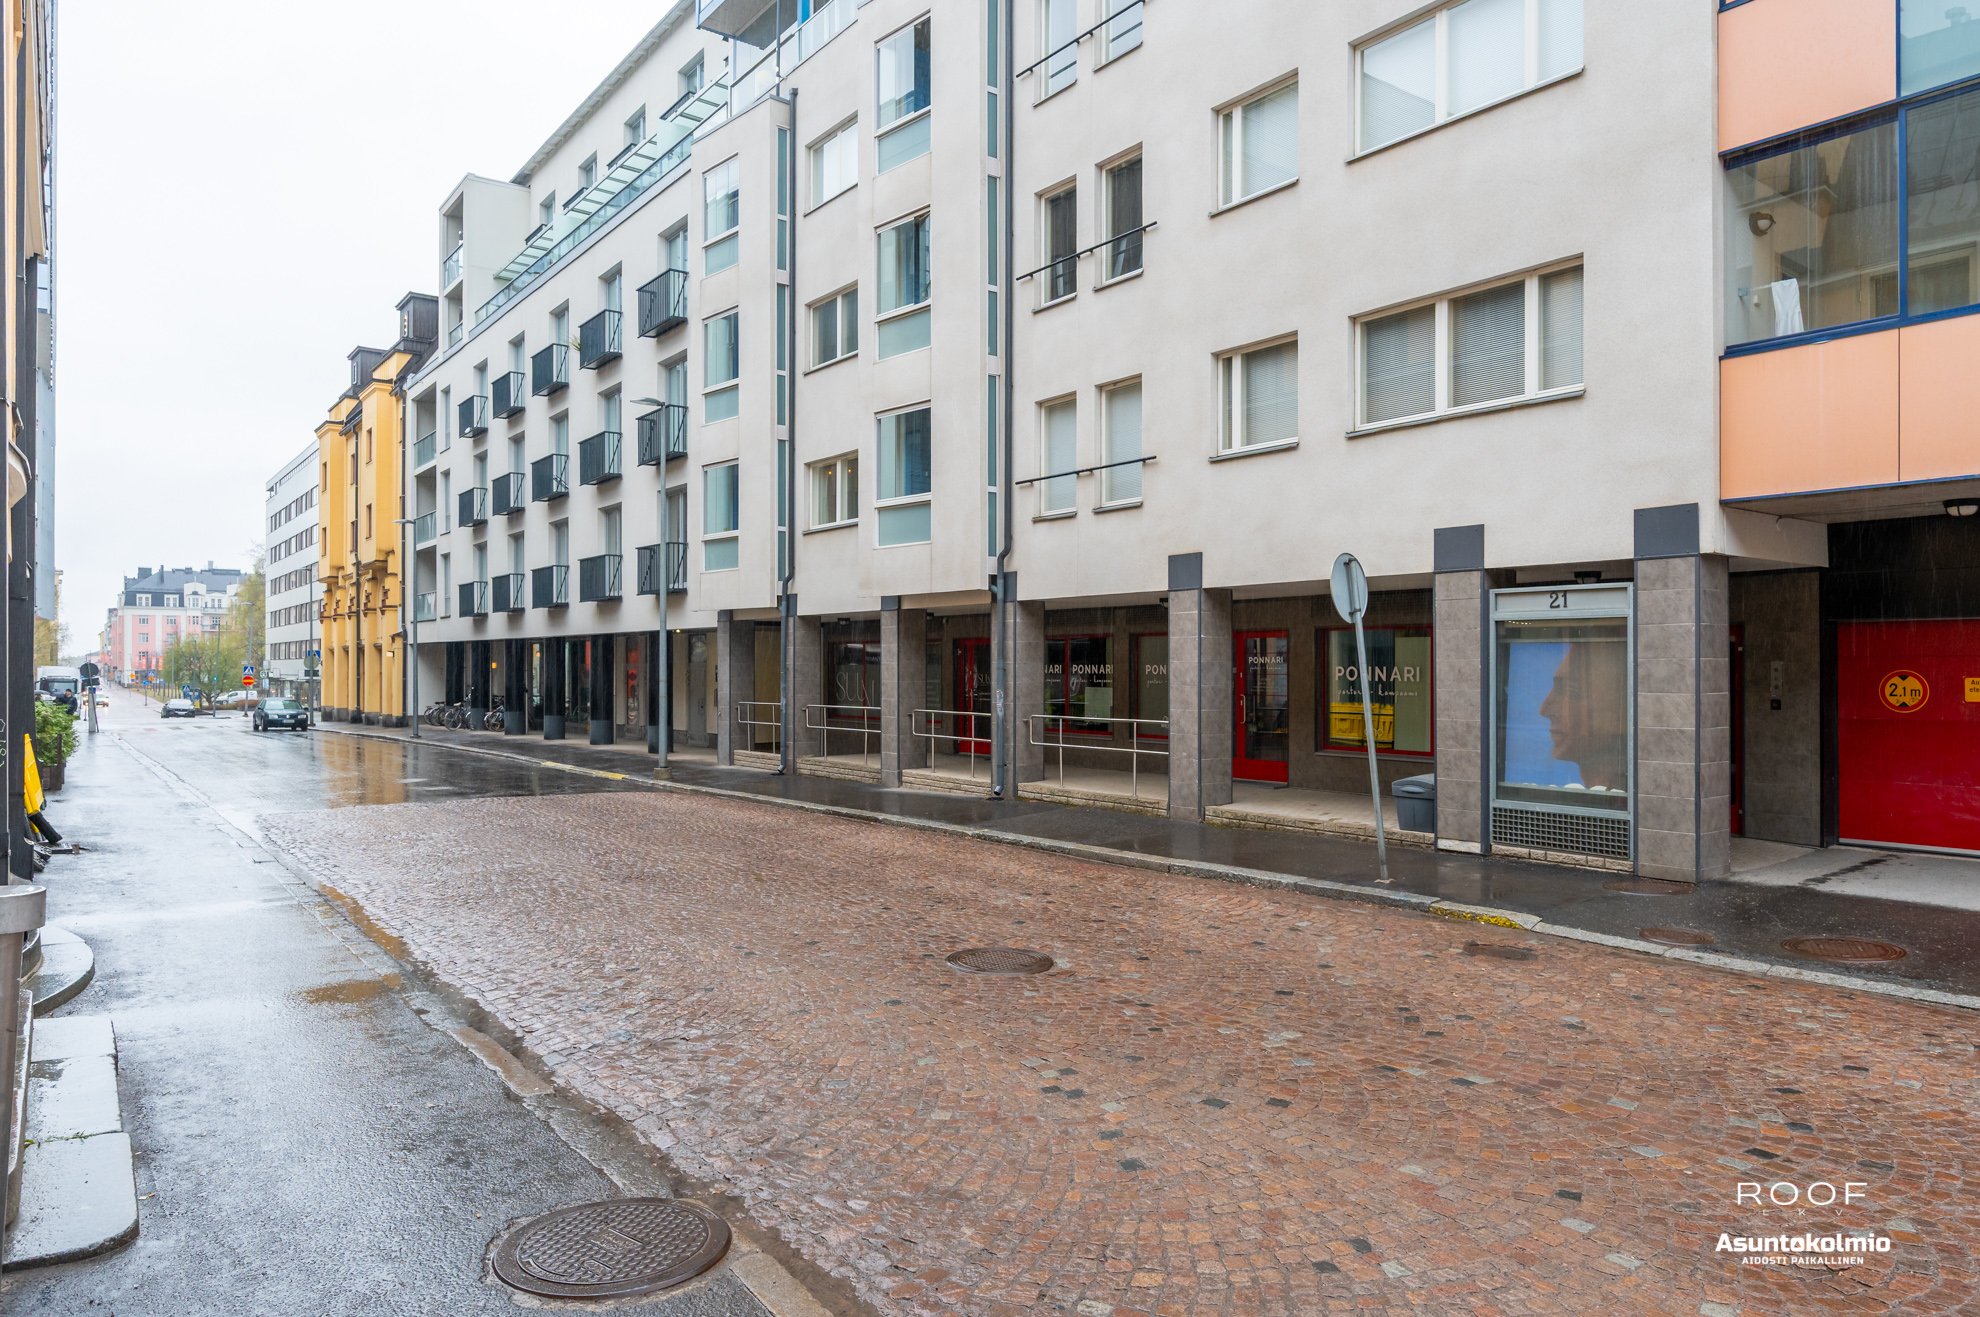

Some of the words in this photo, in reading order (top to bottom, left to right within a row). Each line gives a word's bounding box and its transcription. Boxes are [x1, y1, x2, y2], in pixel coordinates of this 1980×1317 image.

[1549, 591, 1568, 609] 21
[1248, 656, 1283, 664] PONNARI
[1072, 664, 1113, 674] PONNARI
[1910, 688, 1921, 697] m
